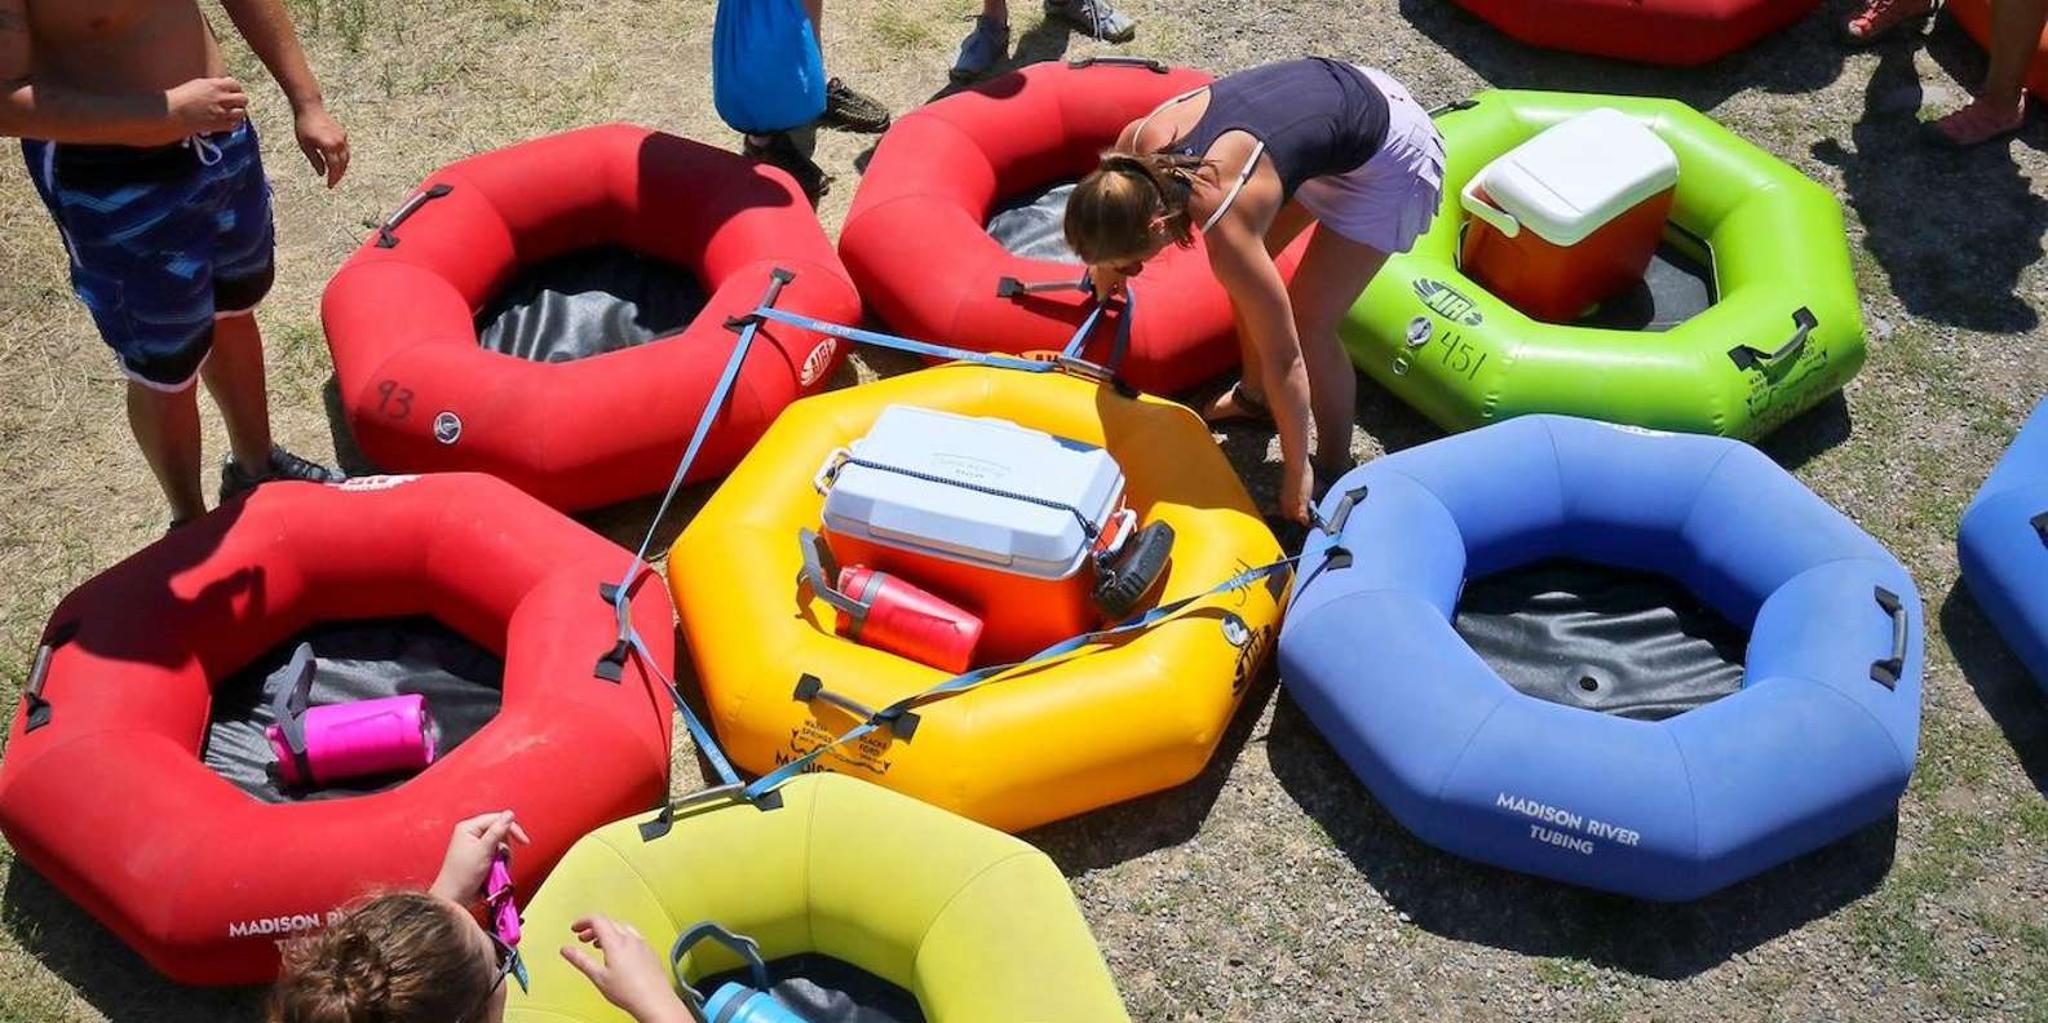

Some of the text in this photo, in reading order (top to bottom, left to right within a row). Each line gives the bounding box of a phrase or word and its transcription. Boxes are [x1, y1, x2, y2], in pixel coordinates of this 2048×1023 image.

[1441, 331, 1487, 380] 451
[379, 380, 414, 418] 93
[1496, 792, 1641, 846] MADISON RIVER
[1530, 825, 1594, 855] TUBING
[229, 913, 320, 937] MADISON
